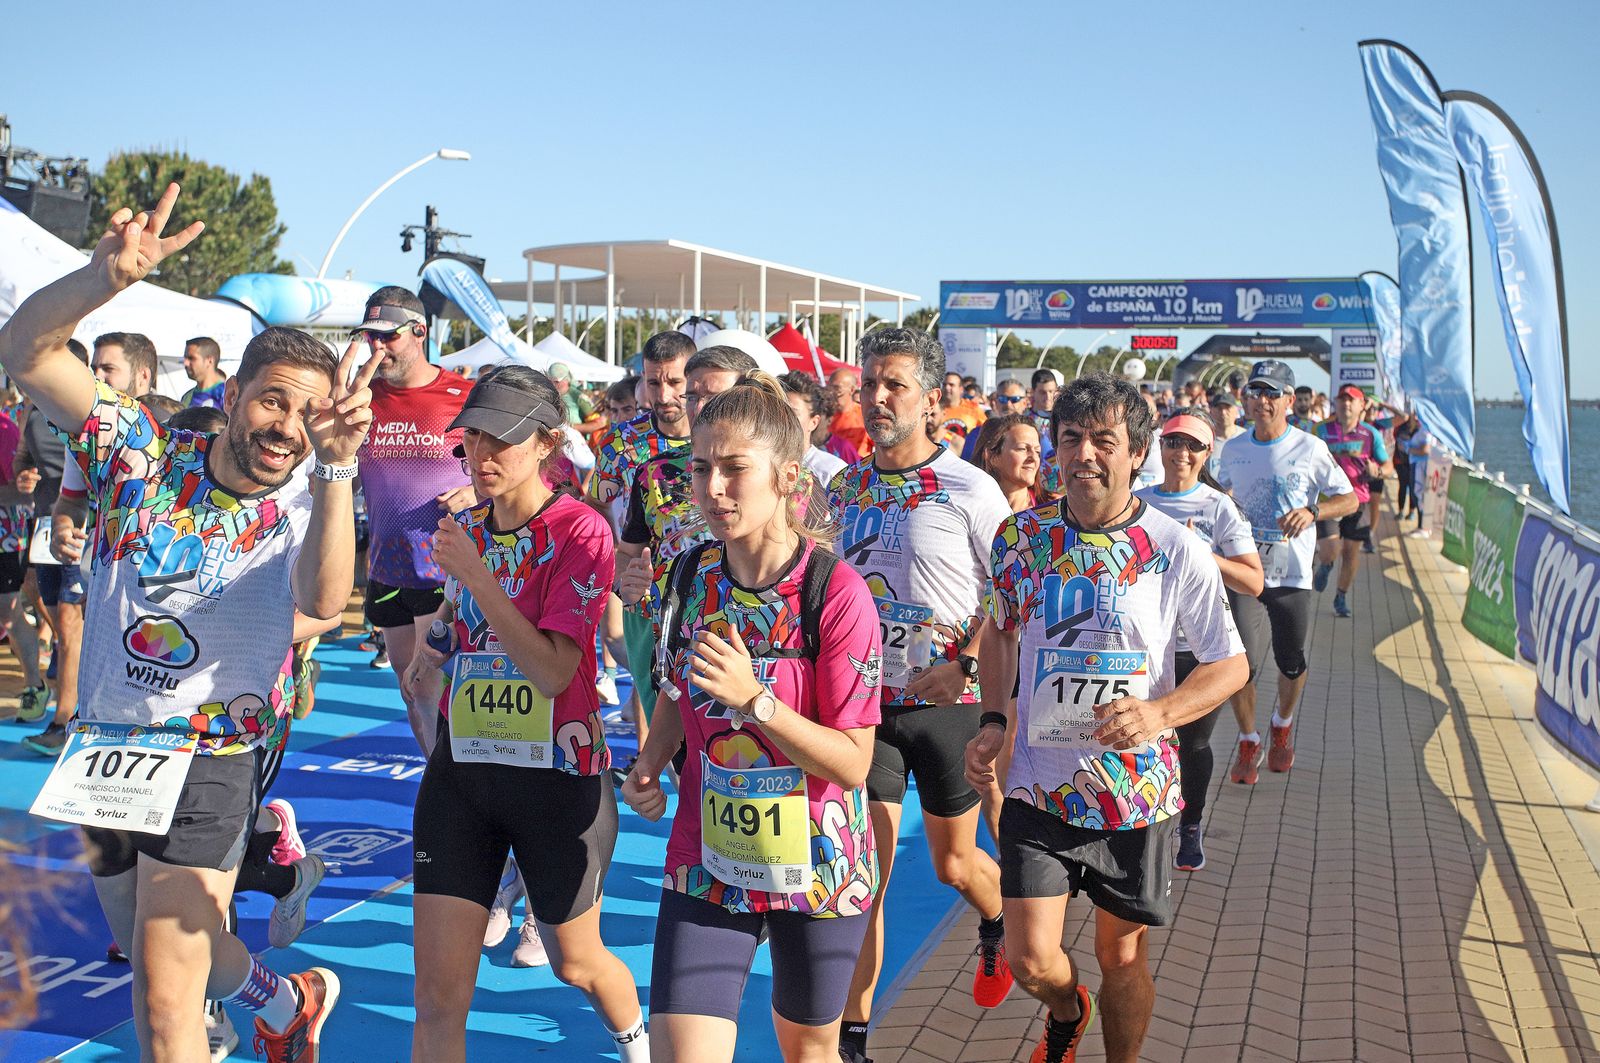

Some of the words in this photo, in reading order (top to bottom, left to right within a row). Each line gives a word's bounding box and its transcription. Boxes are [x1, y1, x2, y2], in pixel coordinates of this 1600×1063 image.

[1087, 285, 1188, 298] CAMPEONATO
[1086, 301, 1103, 313] de
[1105, 299, 1156, 313] ESPAÑA
[1163, 298, 1188, 314] 10
[1191, 297, 1223, 314] km
[1235, 287, 1263, 321] 10
[1262, 293, 1304, 307] HUELVA
[376, 421, 418, 434] MEDIA
[373, 430, 445, 446] MARATÓN
[421, 450, 445, 459] 2022
[883, 507, 910, 522] HU
[881, 521, 904, 536] EL
[205, 538, 243, 563] HU
[880, 536, 902, 551] VA
[200, 557, 231, 581] EL
[197, 576, 225, 598] VA
[1097, 577, 1129, 598] HU
[1096, 595, 1126, 615] EL
[897, 608, 925, 622] 2023
[1096, 612, 1123, 631] VA
[471, 661, 490, 671] HUELVA
[1058, 655, 1082, 666] HUELVA
[1106, 656, 1139, 672] 2023
[126, 661, 180, 692] WiHu
[1051, 676, 1130, 705] 1775
[464, 683, 534, 716] 1440
[1078, 711, 1096, 719] JOS
[486, 720, 508, 729] ISABEL
[1059, 719, 1093, 728] SOBRINO
[149, 731, 185, 747] 2023
[475, 729, 501, 740] ORTEGA
[500, 731, 523, 741] CANTO
[1038, 734, 1073, 743] HYUNDAI
[1079, 732, 1094, 742] Syr
[493, 743, 517, 755] Syrluz
[84, 750, 170, 782] 1077
[73, 782, 121, 794] FRANCISCO
[121, 785, 154, 797] MANUEL
[756, 775, 793, 793] 2023
[89, 794, 134, 805] GONZALEZ
[46, 804, 85, 817] HYUNDAI
[94, 808, 128, 820] Syrluz
[708, 794, 781, 837] 1491
[725, 839, 757, 852] ANGELA
[733, 866, 765, 881] Syrluz
